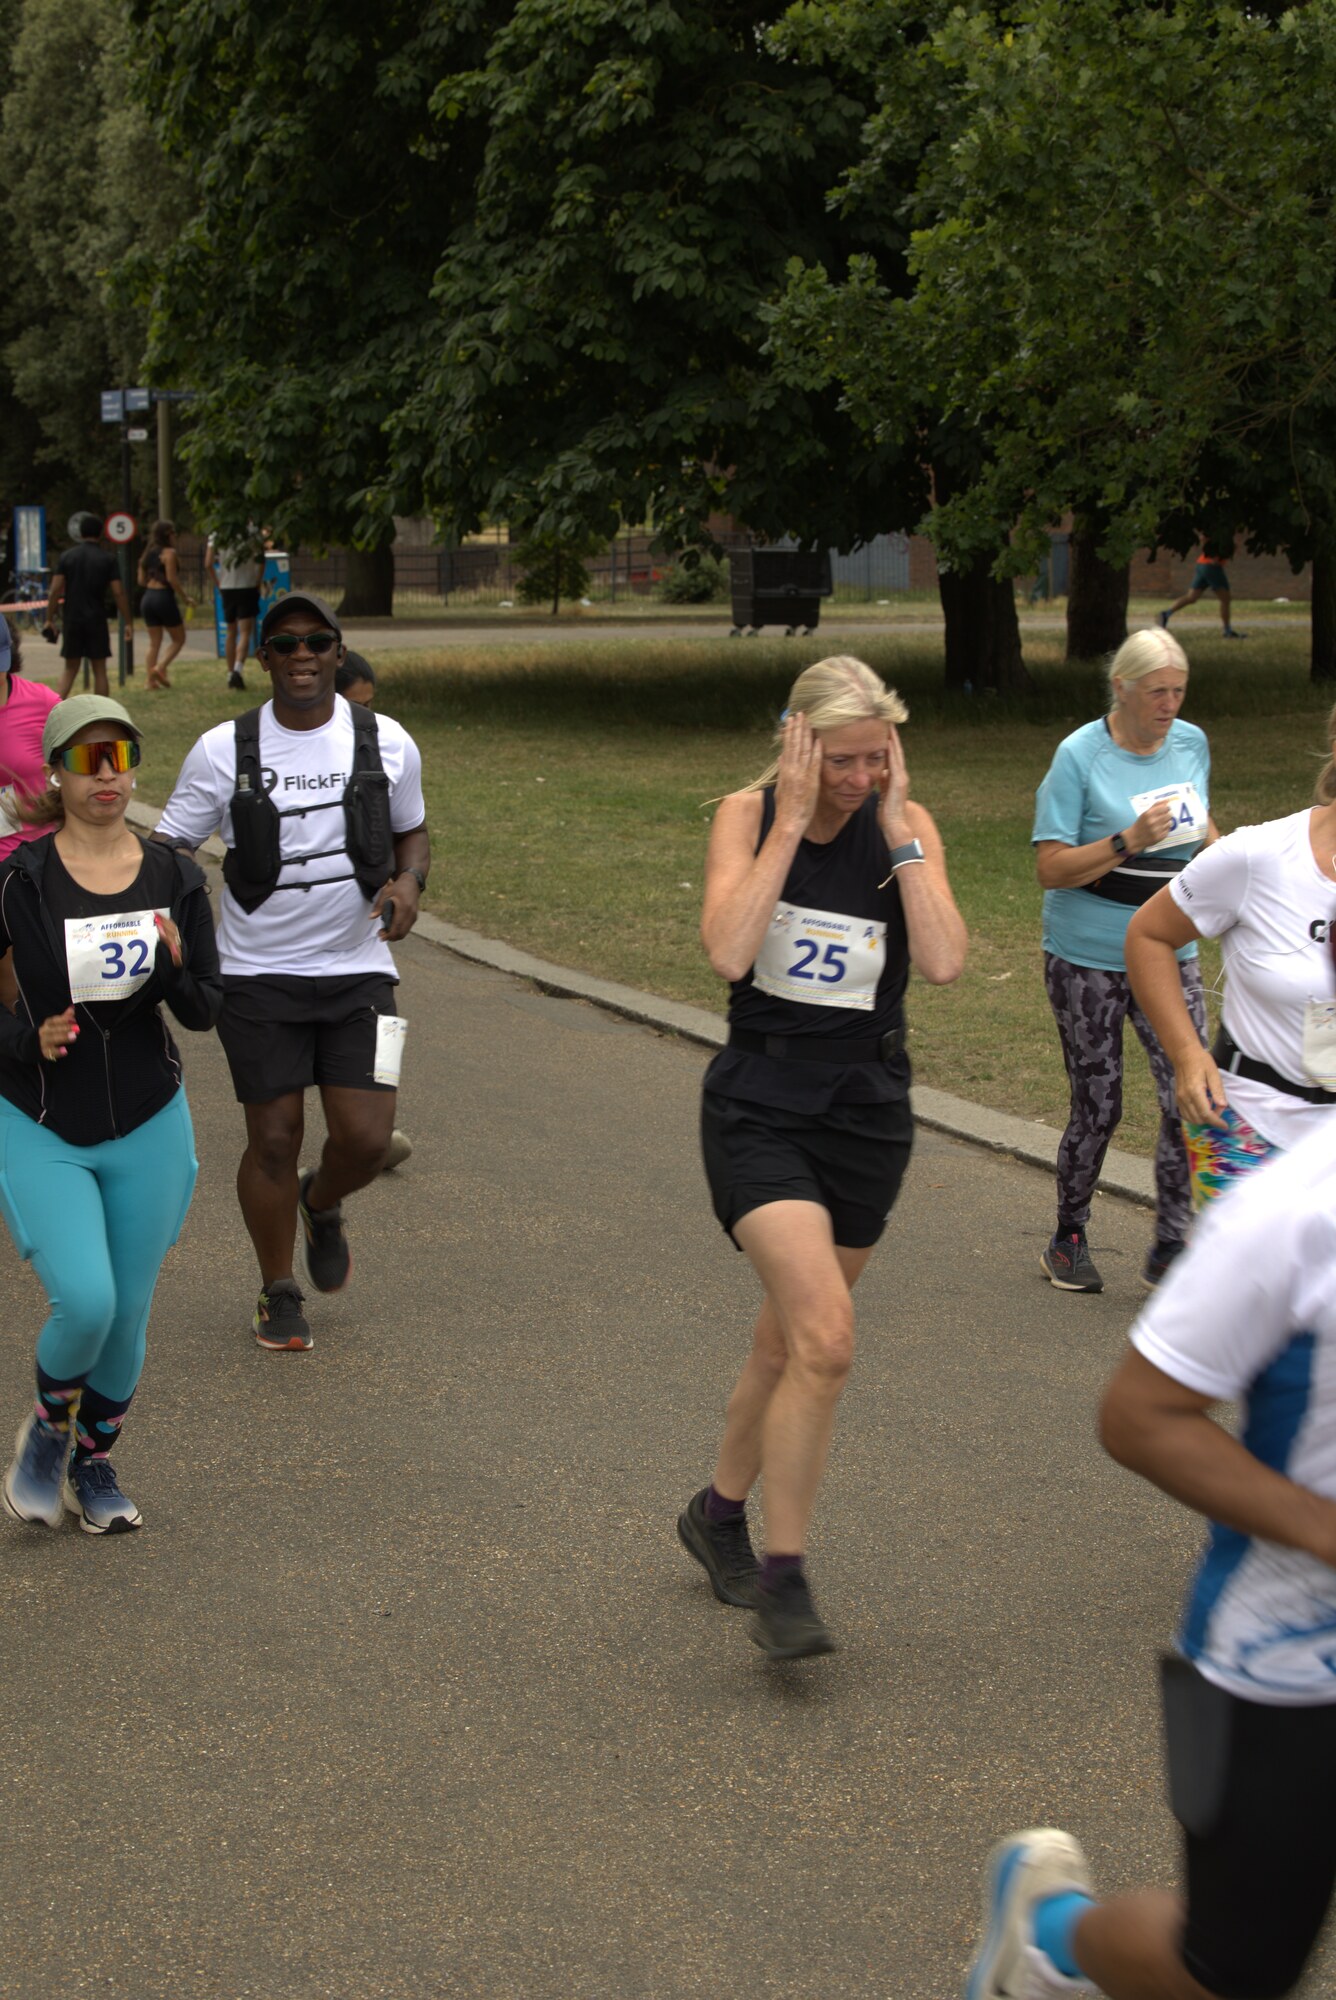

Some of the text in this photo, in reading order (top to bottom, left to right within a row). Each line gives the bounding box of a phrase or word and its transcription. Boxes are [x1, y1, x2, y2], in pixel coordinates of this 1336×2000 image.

[115, 521, 125, 535] 5
[100, 920, 141, 931] AFFORDABLE
[105, 929, 139, 939] RUNNING
[99, 939, 151, 980] 32
[786, 938, 849, 984] 25
